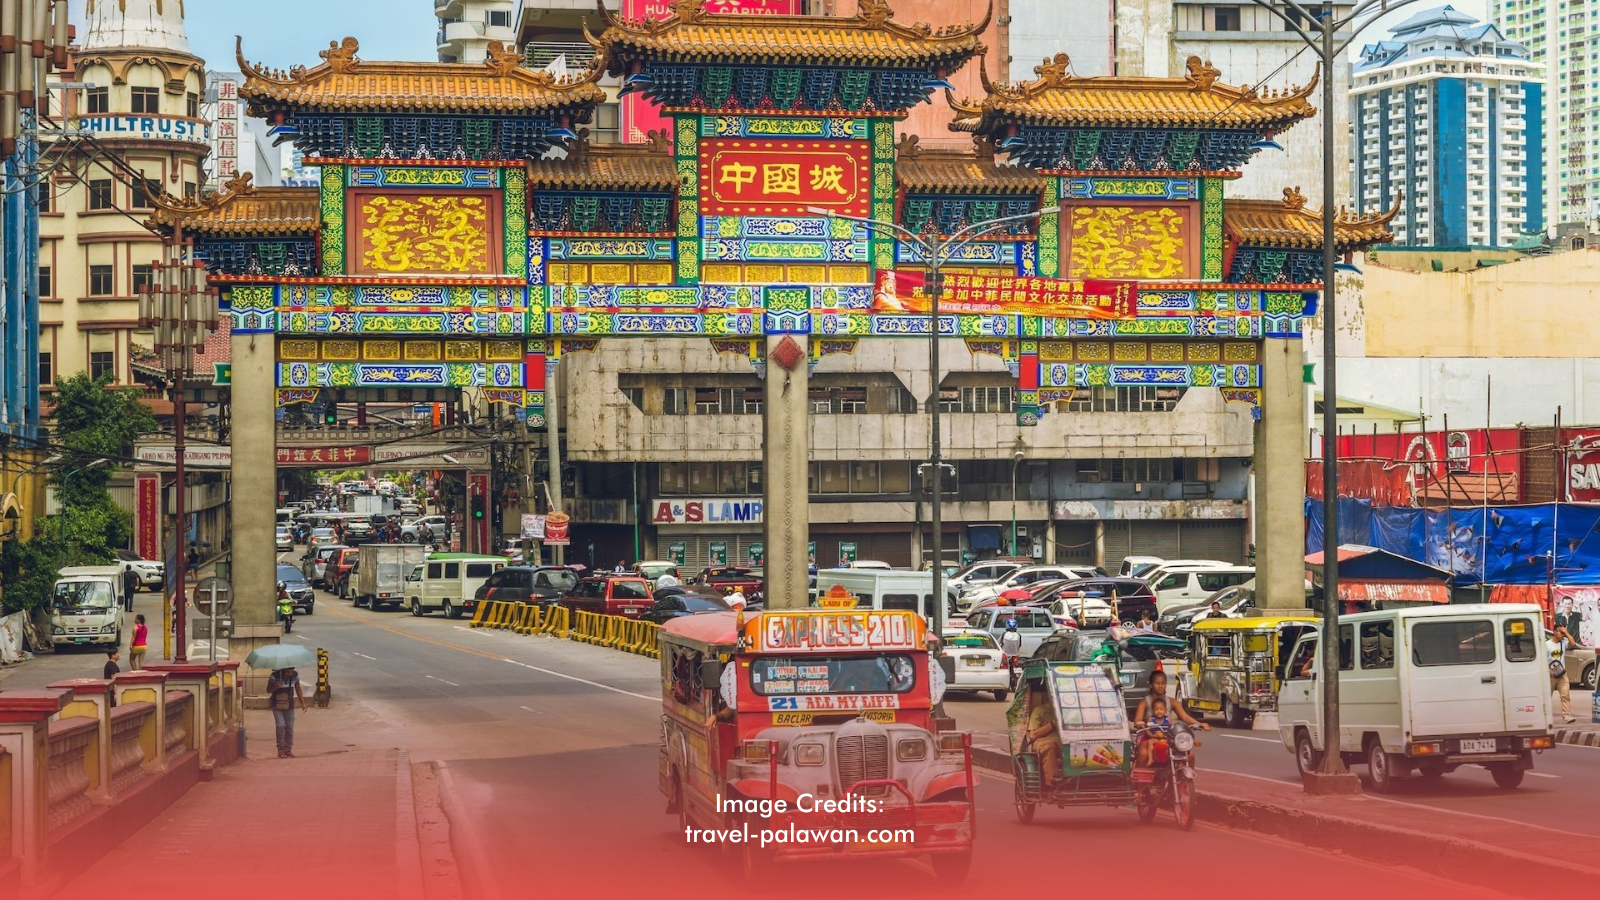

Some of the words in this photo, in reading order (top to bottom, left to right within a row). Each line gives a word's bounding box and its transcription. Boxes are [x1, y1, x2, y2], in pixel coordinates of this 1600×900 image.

[80, 117, 196, 136] PHILTRUST
[719, 161, 848, 196] 中國城
[943, 275, 1085, 292] 熱烈歡迎世界各地嘉賓
[912, 286, 1112, 307] 蒞參加中菲民間文化交流活動
[212, 452, 231, 460] PILIPIN
[654, 502, 704, 523] A&S
[771, 697, 798, 710] 21
[806, 696, 829, 709] ALL
[837, 696, 861, 708] MY
[863, 695, 896, 708] LIFE
[777, 712, 813, 724] BACLAR
